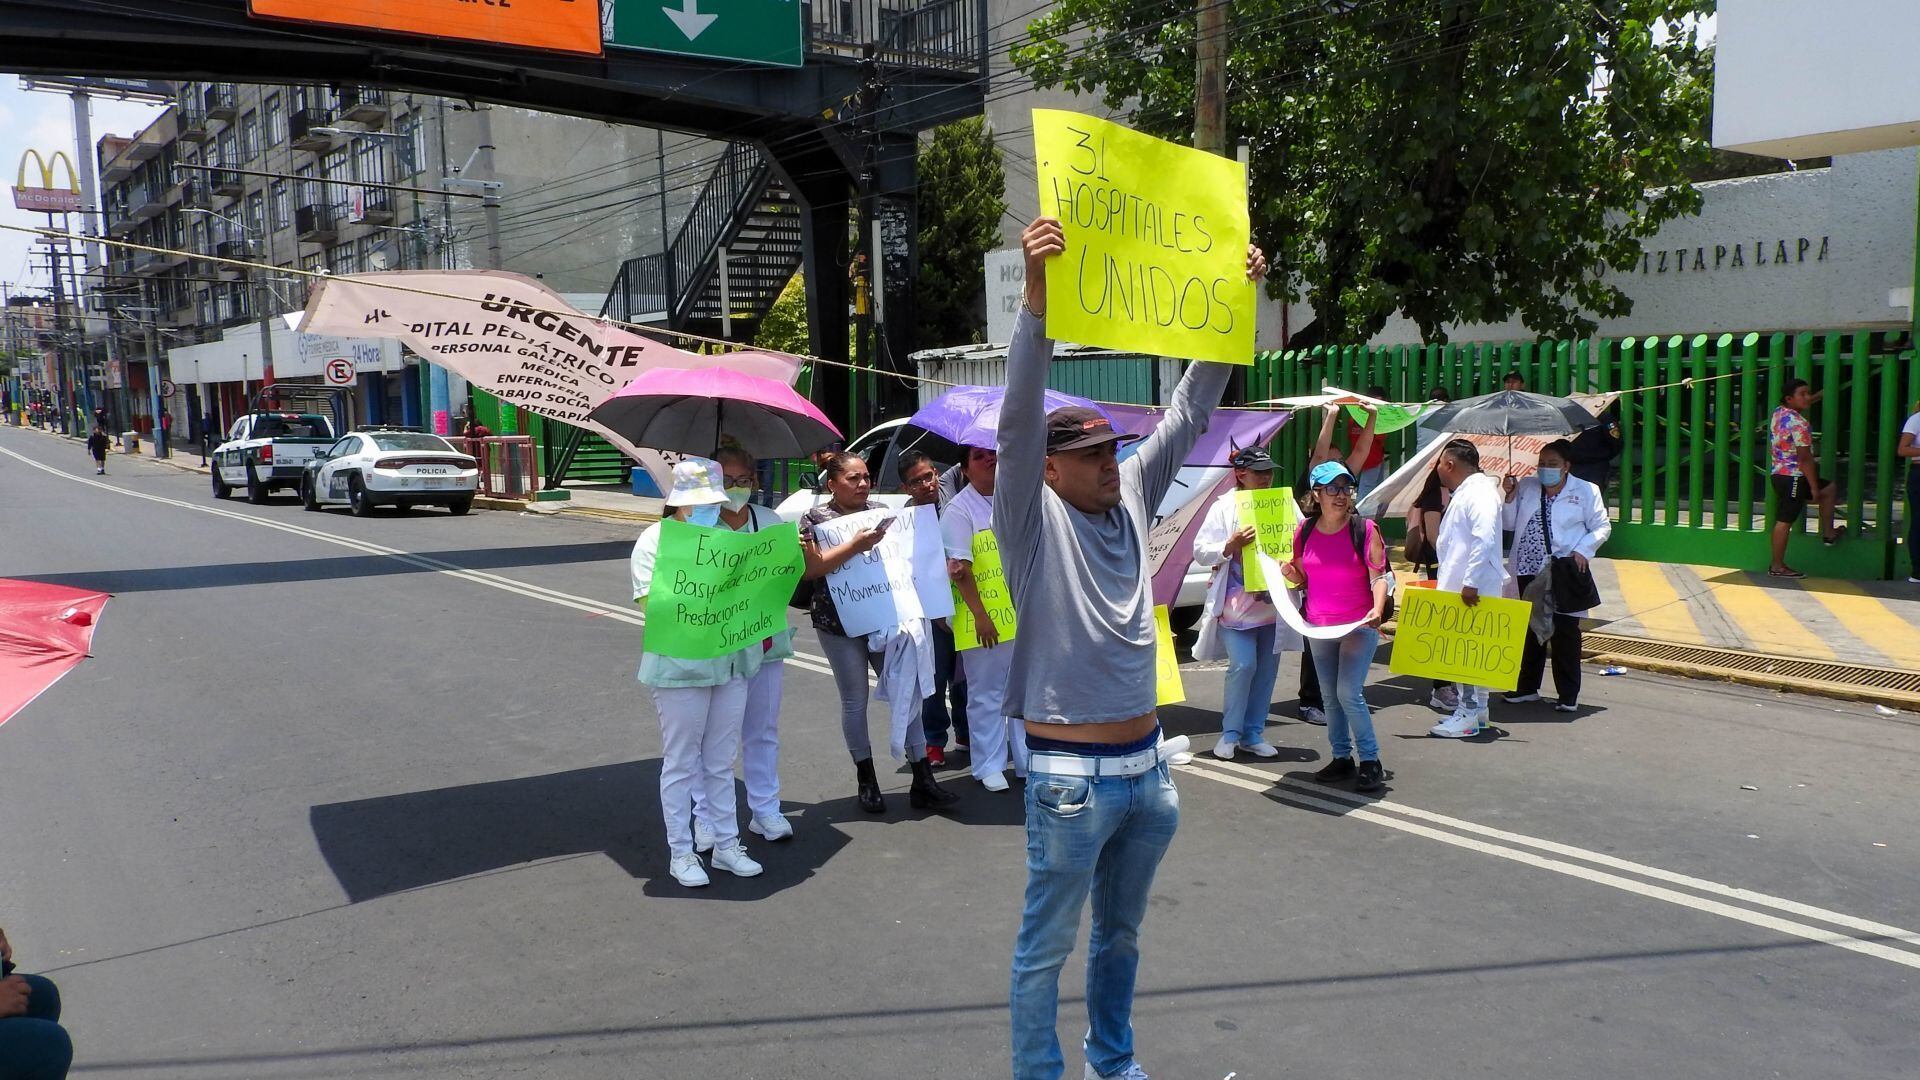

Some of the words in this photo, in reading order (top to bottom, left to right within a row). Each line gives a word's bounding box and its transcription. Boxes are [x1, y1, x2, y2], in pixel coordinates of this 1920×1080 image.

[1067, 126, 1110, 183] 31
[1053, 176, 1213, 254] HOSPITALES
[1000, 264, 1024, 282] HO
[1642, 236, 1830, 275] IZTAPALAPA
[1001, 293, 1021, 313] IZ
[1078, 244, 1234, 335] UNIDOS
[481, 293, 645, 368] URGENTE
[362, 343, 382, 364] Hora
[482, 322, 615, 386] PEDIÁTRICO
[496, 373, 591, 403] ENFERMERÍA
[520, 362, 580, 387] MÉDICA
[520, 403, 592, 423] OTERAPIA
[545, 393, 597, 412] SOCIA
[695, 533, 777, 577] Exigimos
[771, 565, 796, 577] con
[677, 598, 750, 627] Prestaciones
[719, 611, 774, 649] Sindicales
[1403, 596, 1511, 640] HOMOLOGAR
[1409, 633, 1516, 675] SALARIOS
